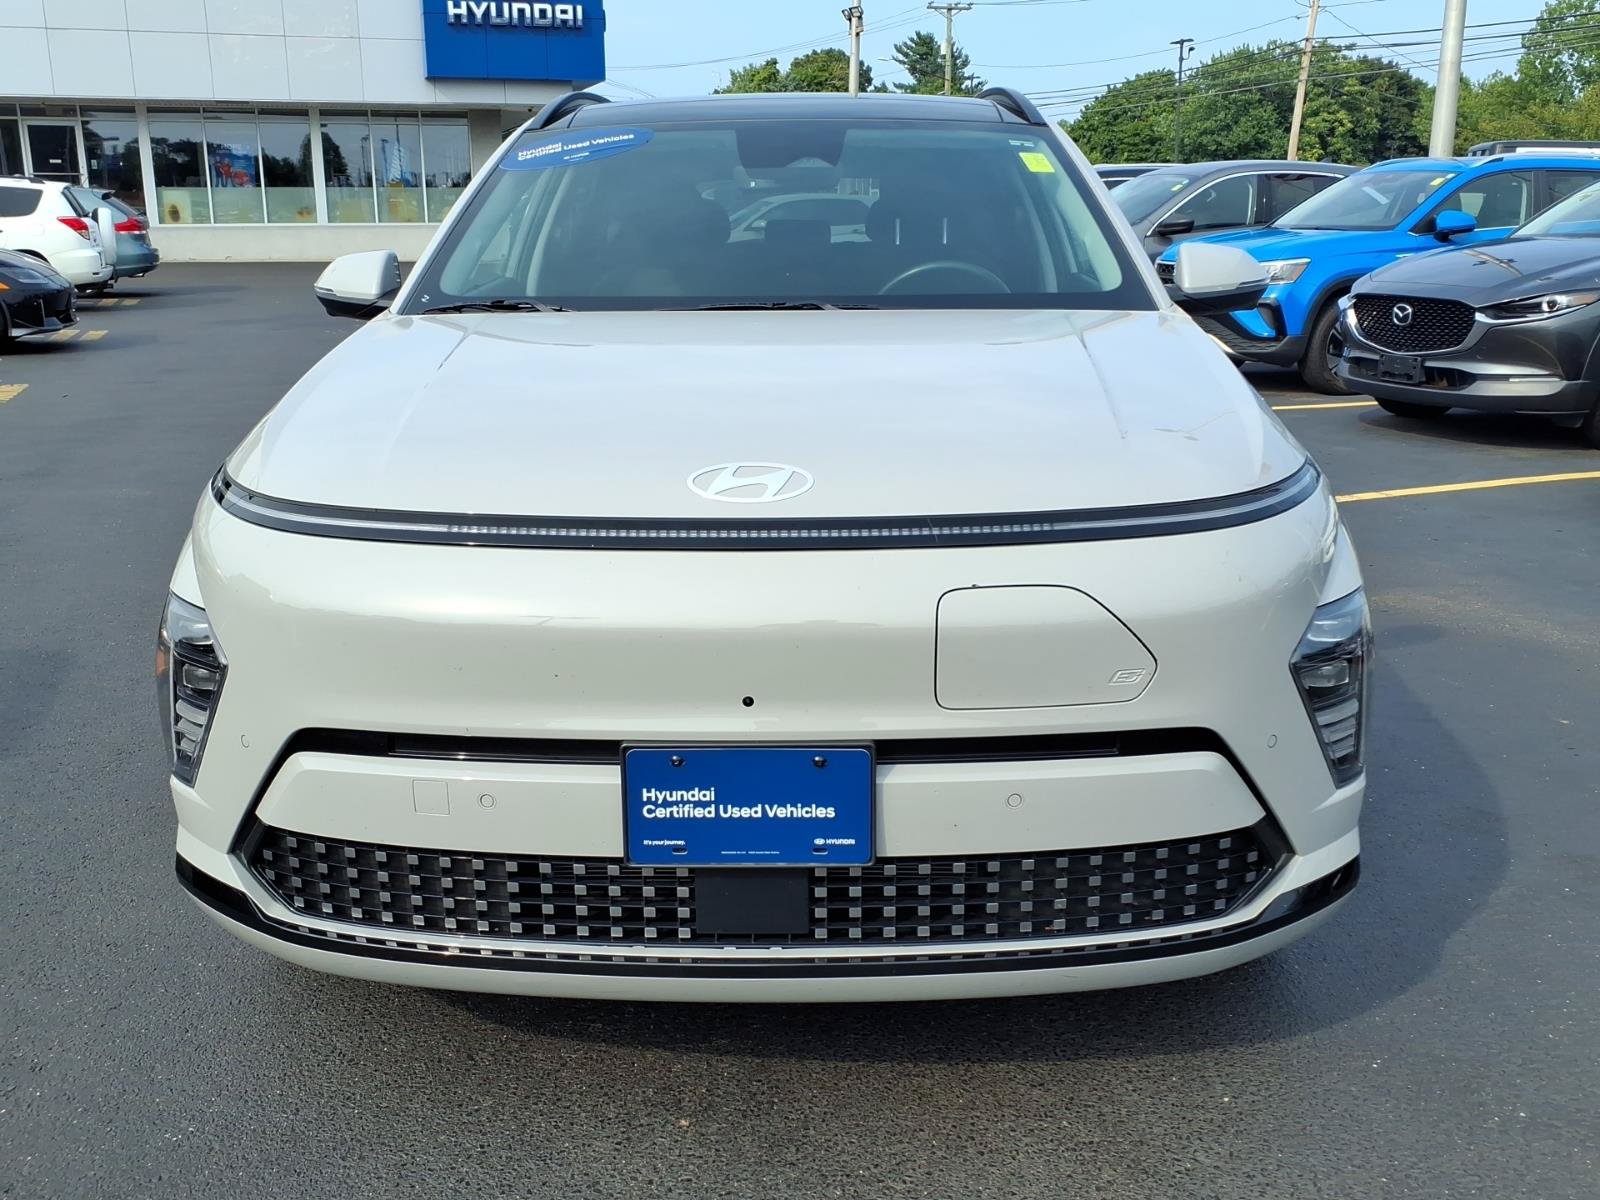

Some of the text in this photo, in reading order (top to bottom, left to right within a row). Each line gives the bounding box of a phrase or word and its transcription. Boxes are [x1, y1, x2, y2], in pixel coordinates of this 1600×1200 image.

[447, 0, 584, 28] HYUNDAI
[518, 142, 562, 157] Hyundai
[563, 141, 590, 150] Used
[592, 134, 635, 145] Vehicles
[642, 787, 715, 804] Hyundai
[642, 804, 836, 818] Certified Used Vehicles
